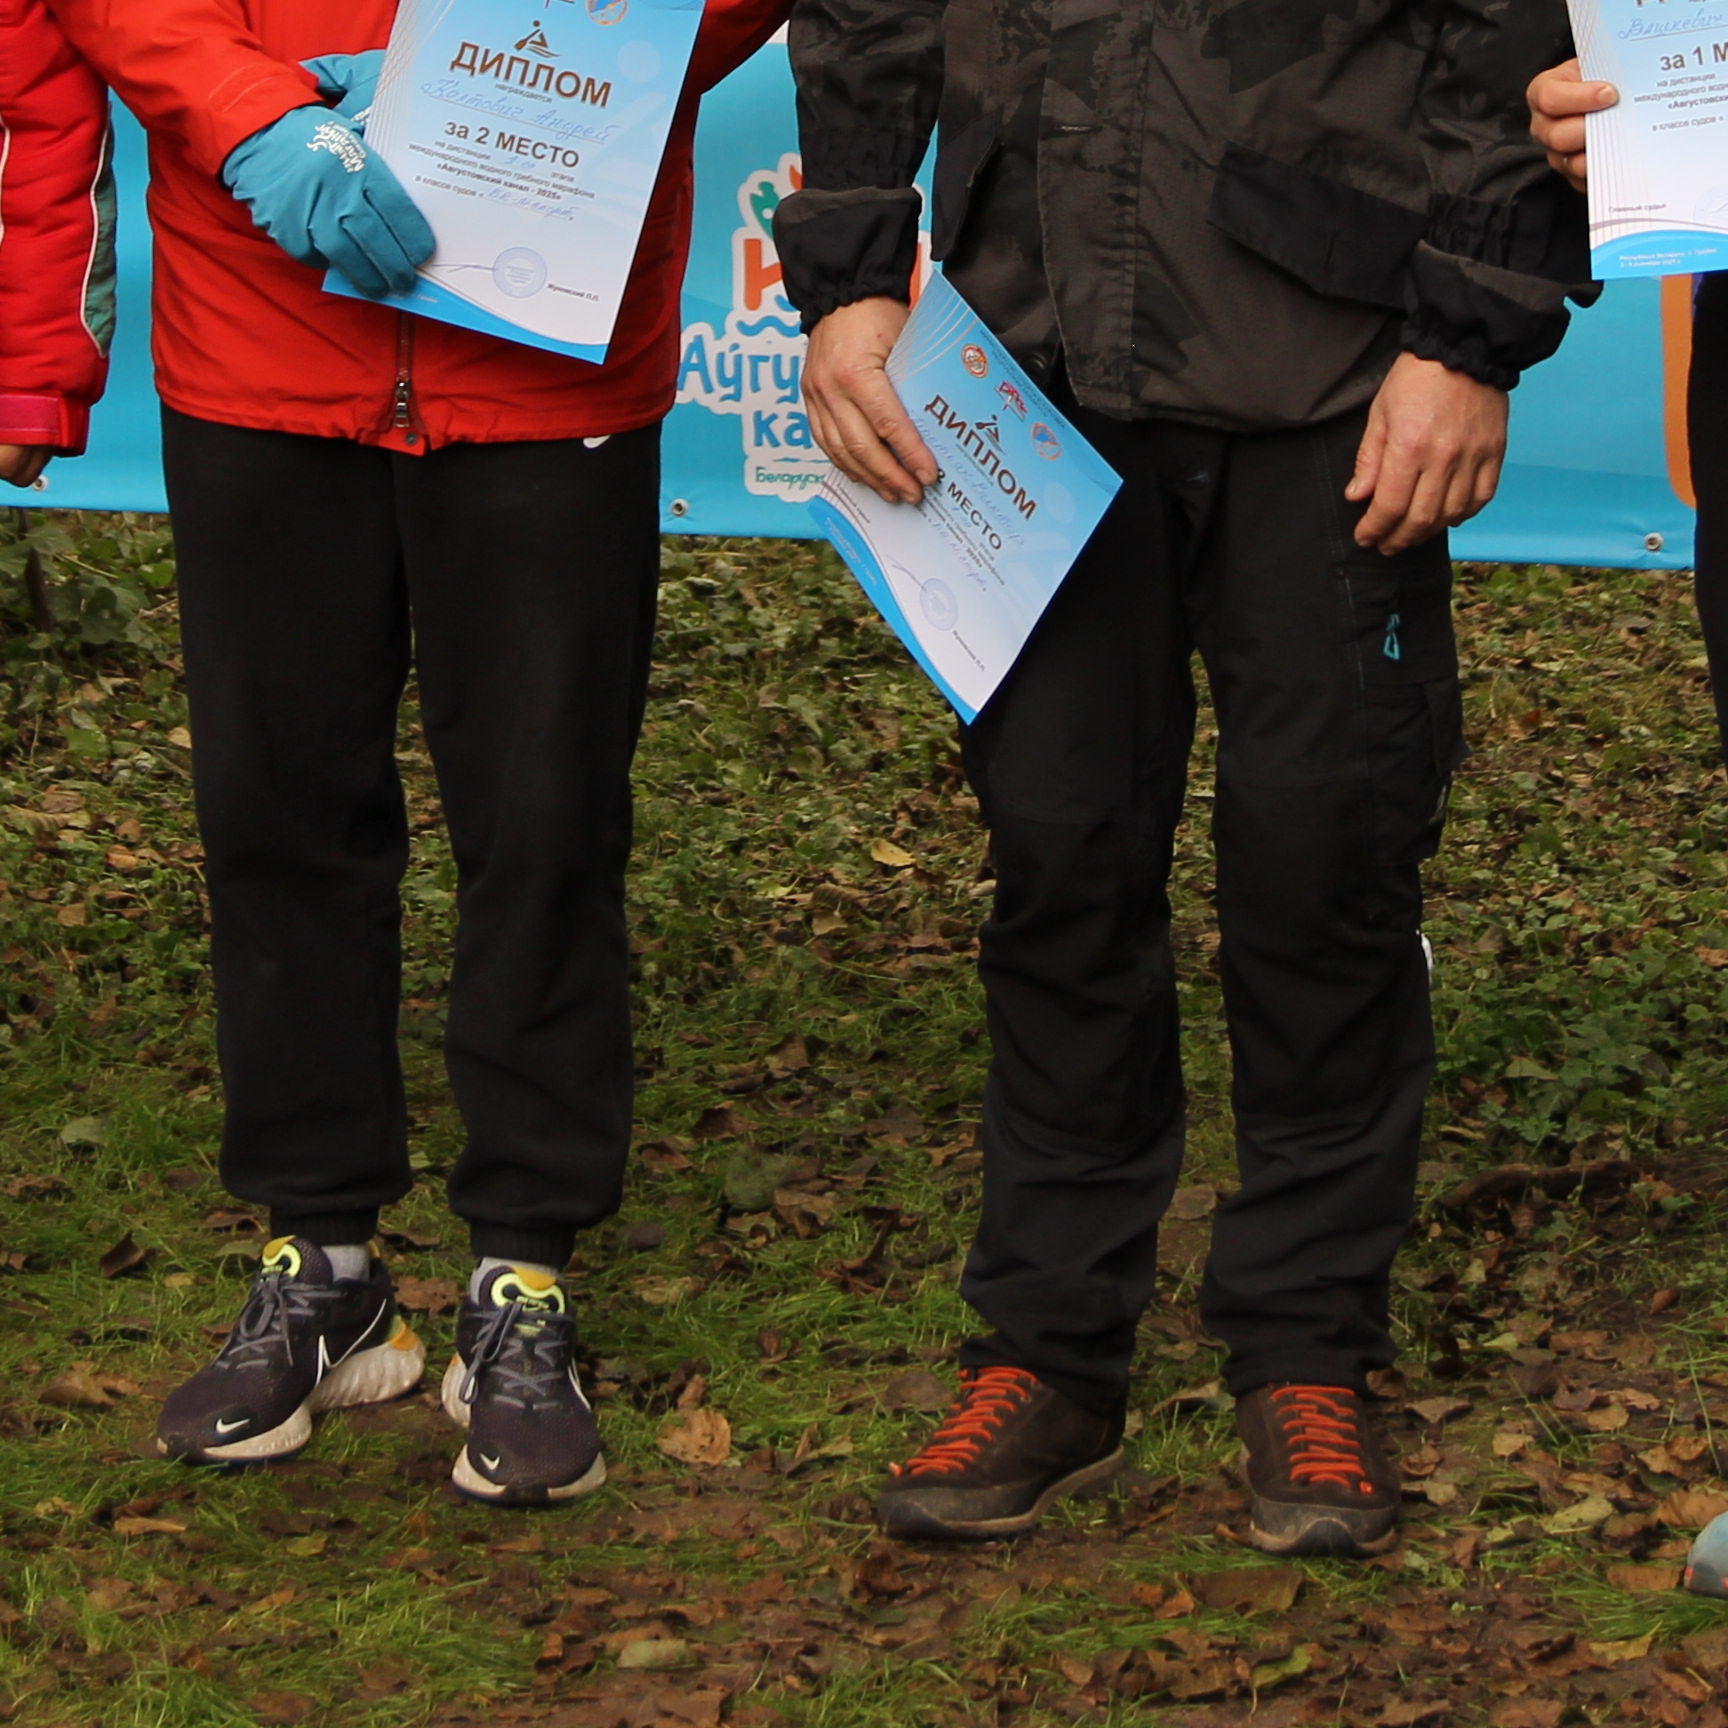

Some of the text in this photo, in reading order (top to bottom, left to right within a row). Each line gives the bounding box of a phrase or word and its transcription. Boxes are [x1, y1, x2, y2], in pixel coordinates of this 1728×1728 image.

[449, 39, 613, 110] ДИПЛОМ
[1656, 79, 1667, 87] на
[1669, 71, 1715, 87] дистанции
[1659, 53, 1685, 71] за
[1691, 46, 1703, 66] 1
[1633, 85, 1706, 104] международного
[443, 121, 581, 169] за 2 МЕСТО
[922, 390, 1041, 524] ДИПЛОМ
[942, 481, 1006, 551] МЕСТО
